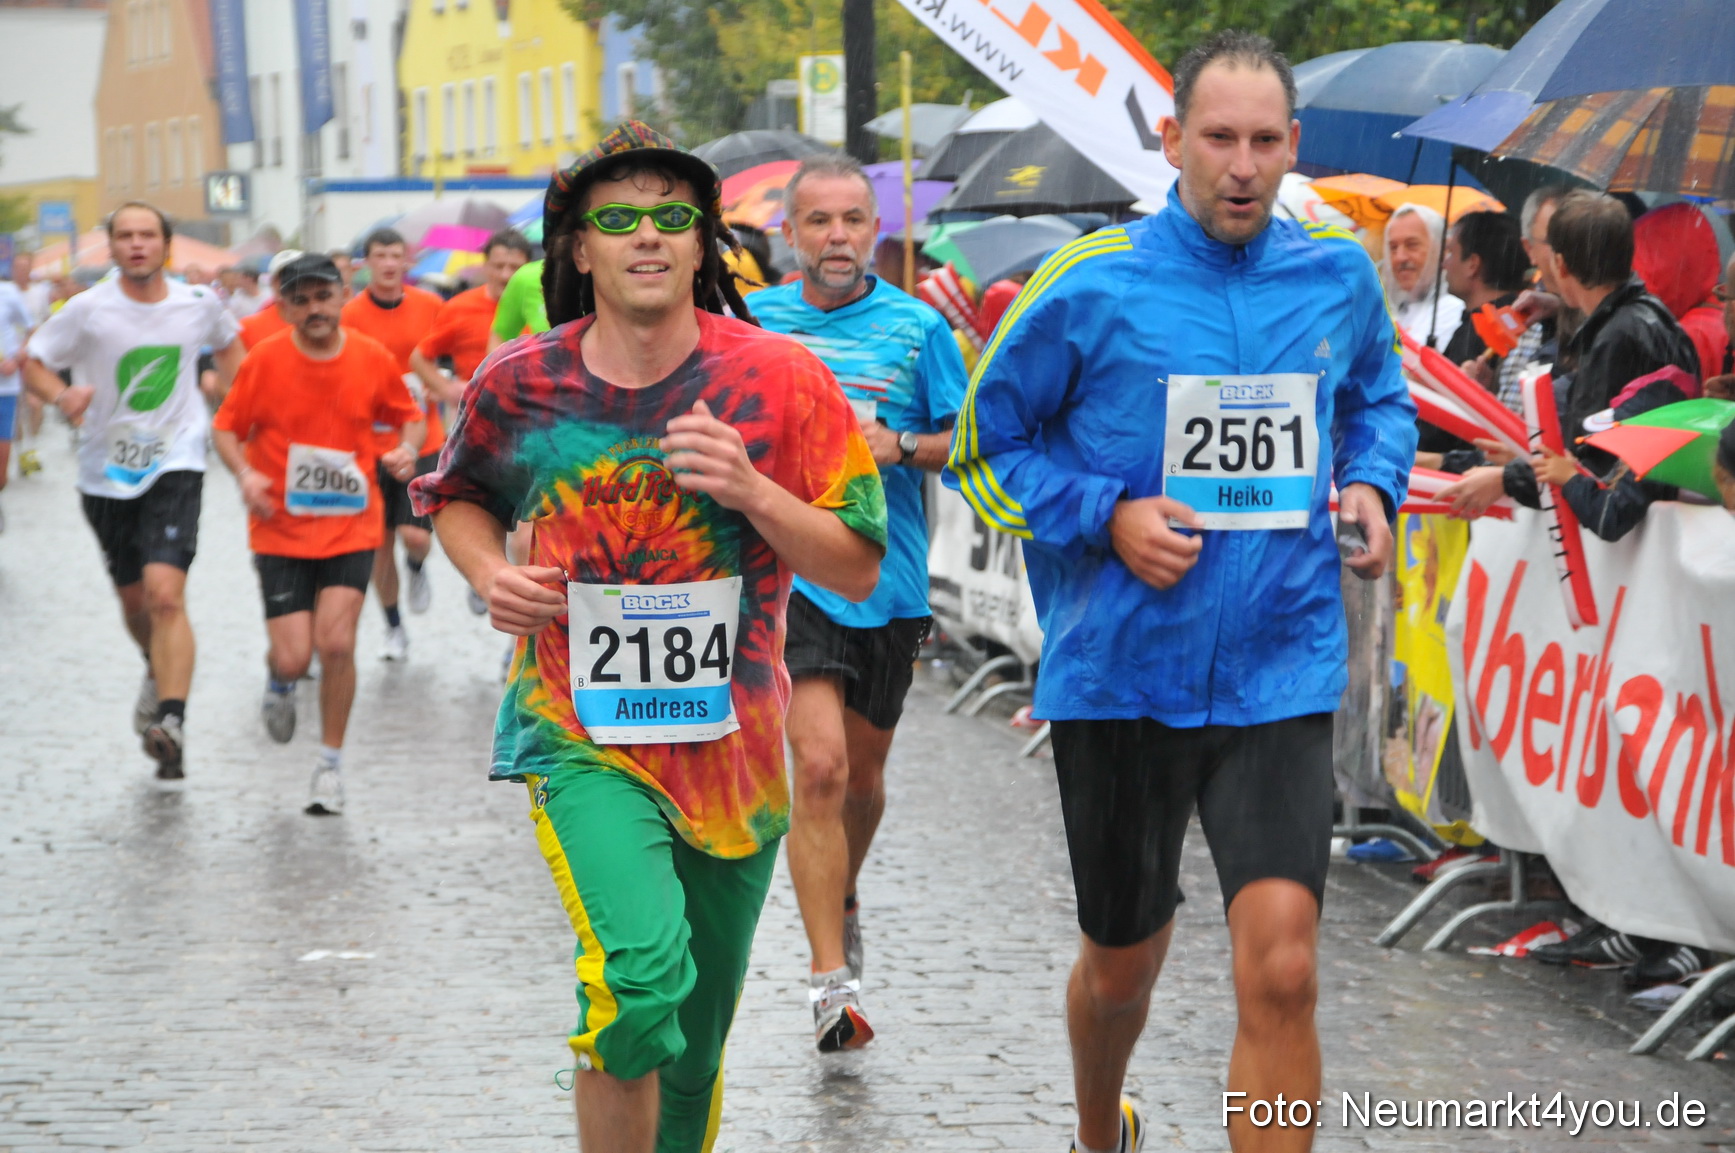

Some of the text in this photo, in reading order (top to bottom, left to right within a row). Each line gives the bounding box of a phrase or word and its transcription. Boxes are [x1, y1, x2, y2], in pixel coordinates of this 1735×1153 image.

[1220, 384, 1274, 400] BOCK
[1182, 415, 1304, 472] 2561
[296, 464, 360, 494] 2906
[583, 472, 643, 506] Hard
[1218, 485, 1273, 507] Heiko
[622, 510, 662, 528] CAFE
[617, 549, 678, 565] JAMAICA
[622, 593, 690, 610] BOCK
[589, 622, 730, 683] 2184
[615, 697, 708, 720] Andreas
